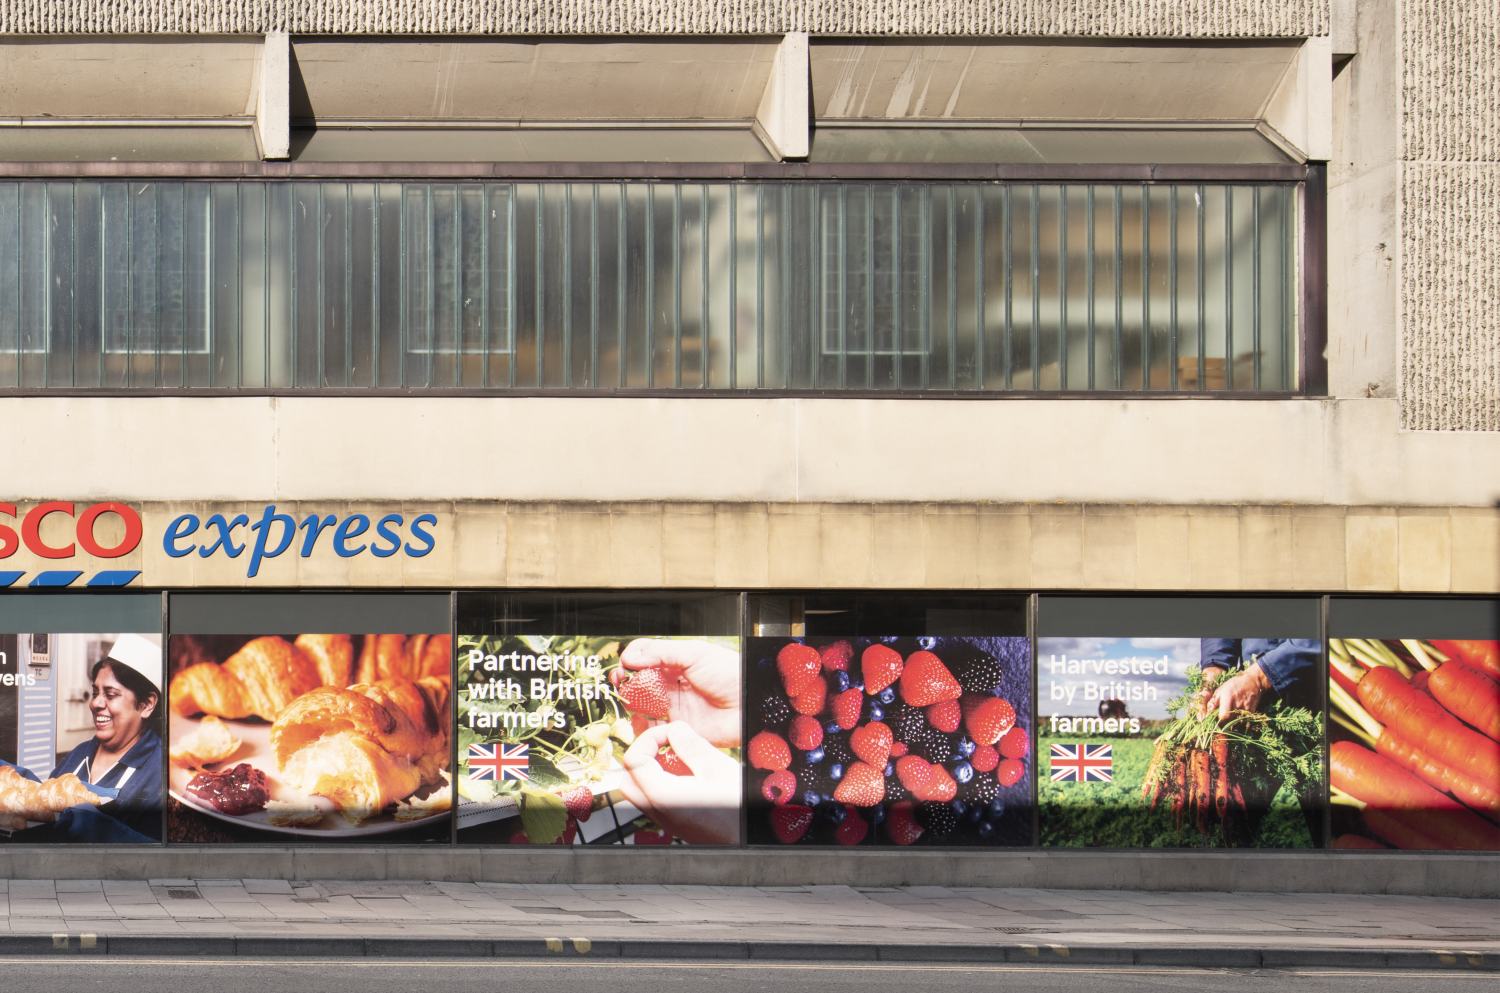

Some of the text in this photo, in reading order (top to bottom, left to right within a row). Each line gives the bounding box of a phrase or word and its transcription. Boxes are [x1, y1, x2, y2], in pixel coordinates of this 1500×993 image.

[162, 505, 437, 578] express
[468, 649, 600, 677] Partnering
[1050, 654, 1169, 675] Harvested
[468, 677, 610, 700] with British
[1050, 680, 1157, 706] by British
[467, 706, 566, 728] farmers
[1050, 712, 1141, 733] farmers
